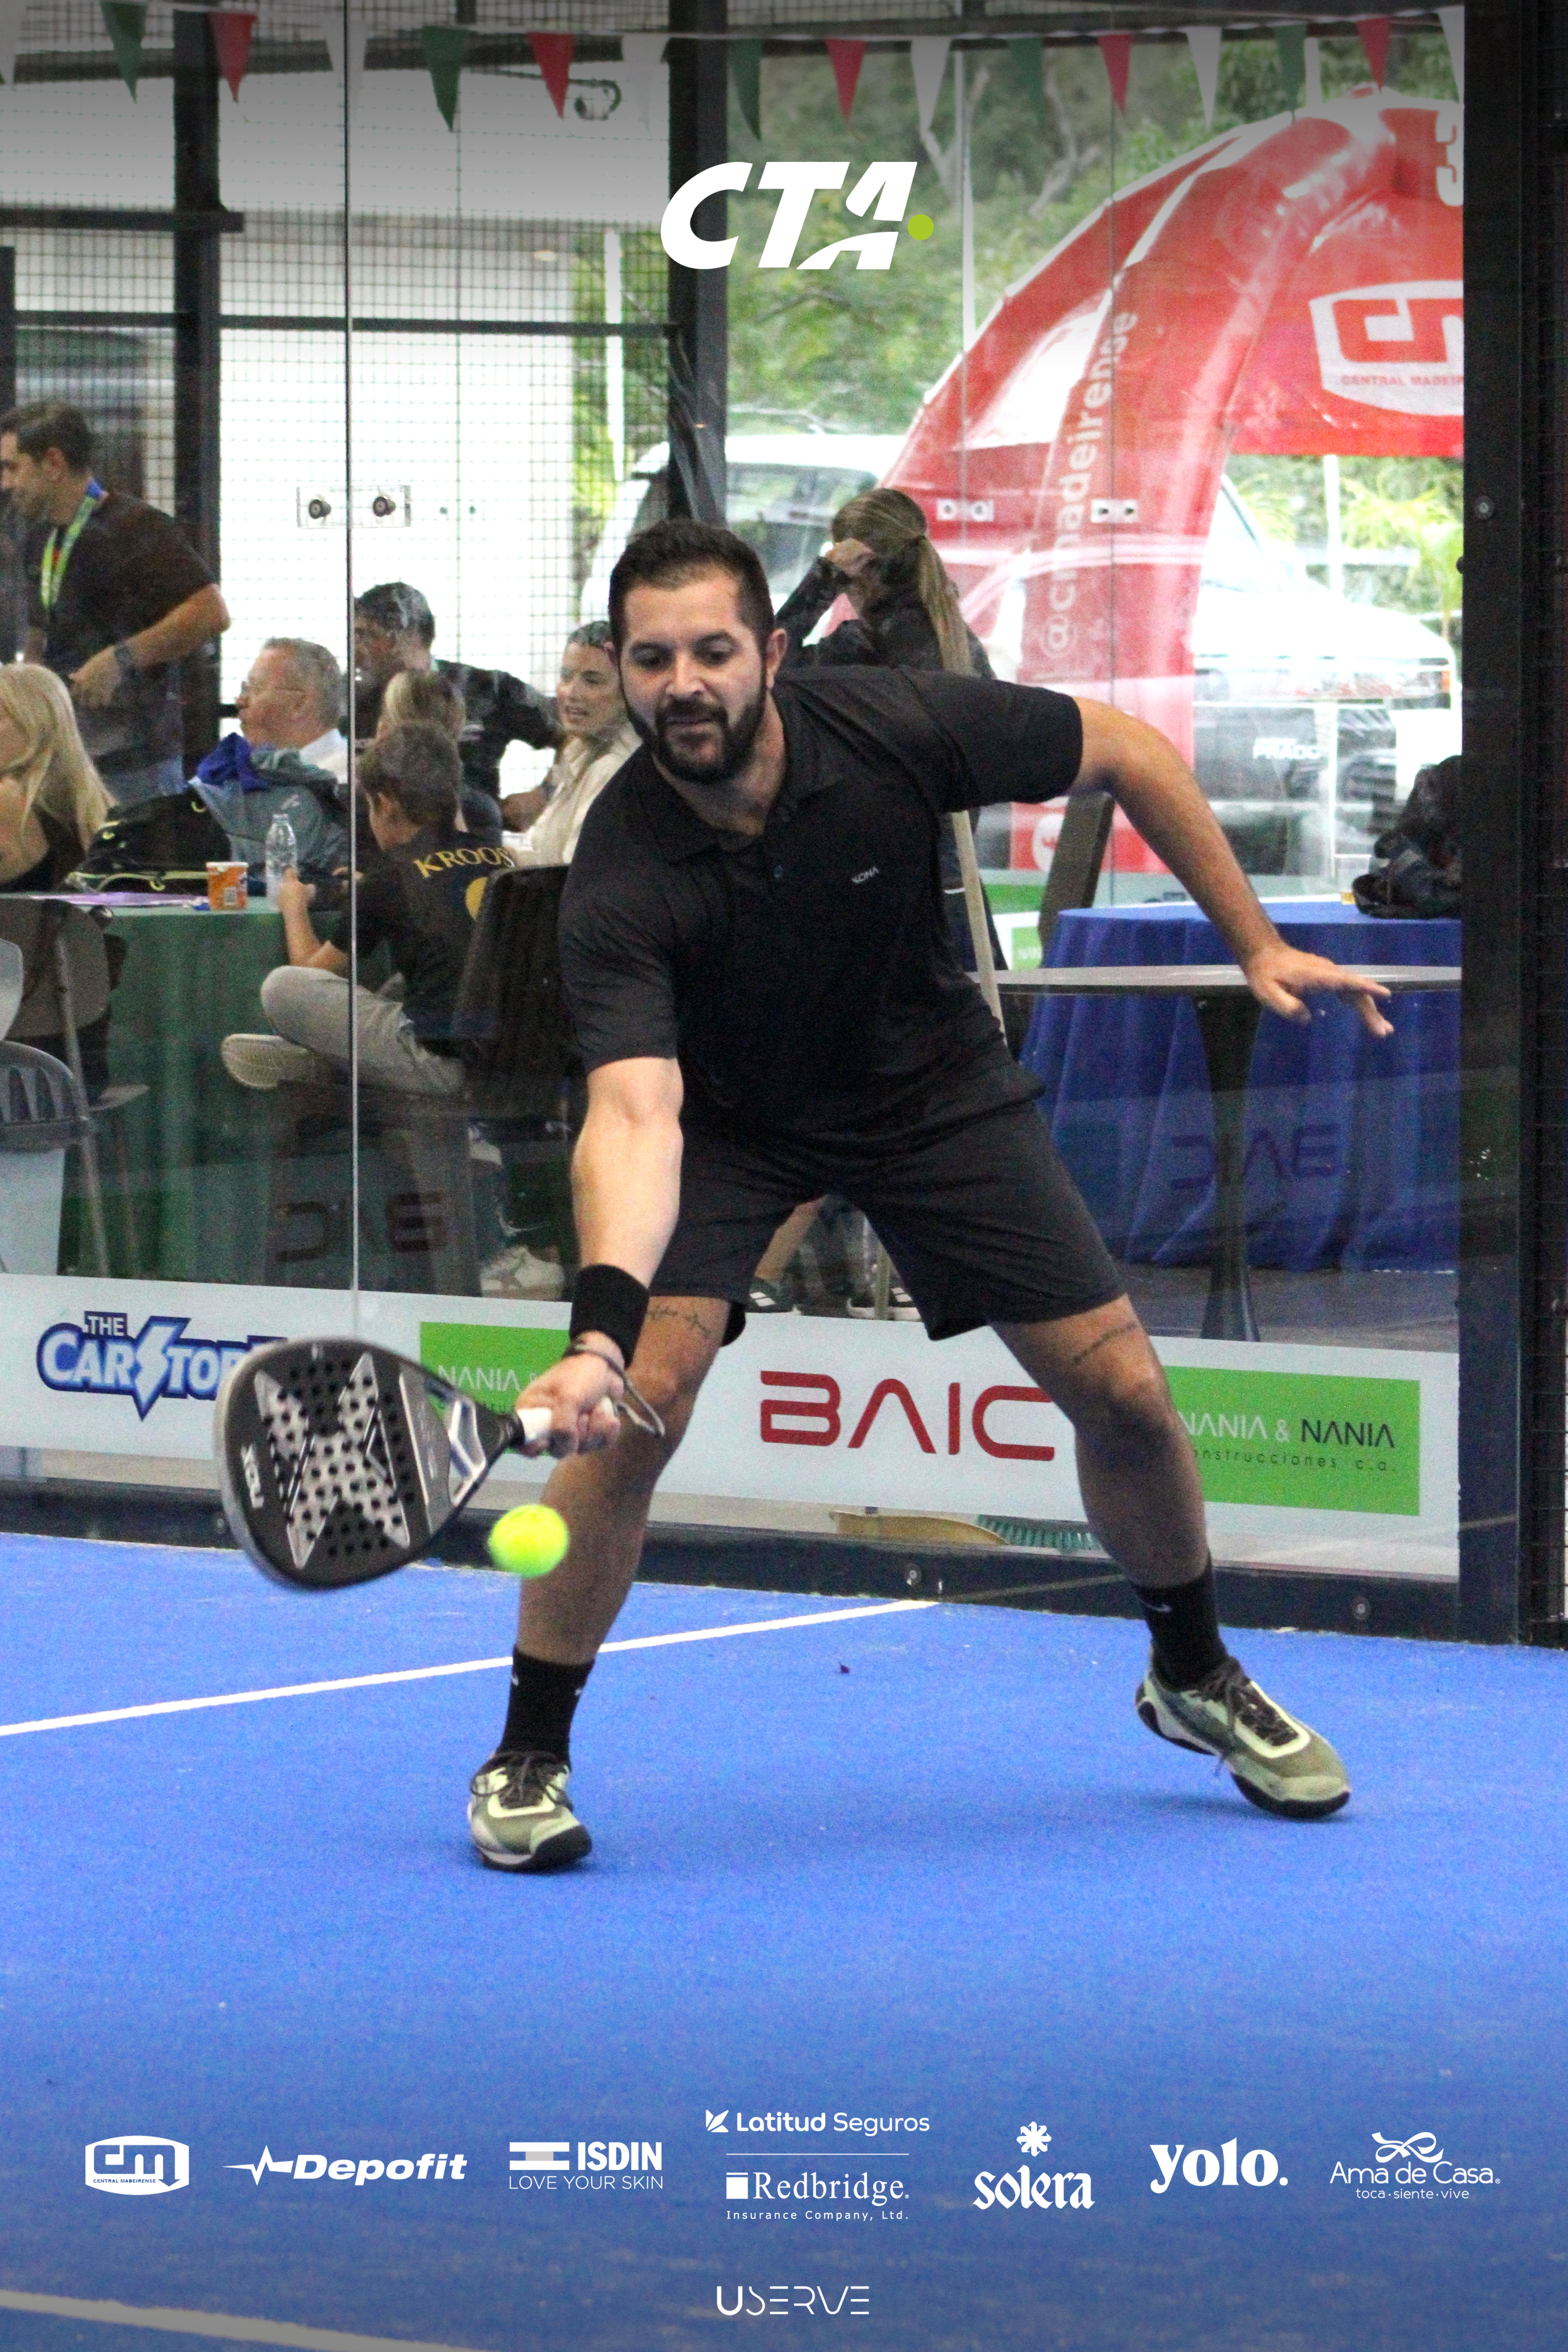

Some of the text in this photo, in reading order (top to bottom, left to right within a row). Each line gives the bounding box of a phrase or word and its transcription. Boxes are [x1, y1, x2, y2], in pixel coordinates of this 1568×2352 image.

[1341, 374, 1405, 386] CENTRAL
[87, 1315, 125, 1336] THE
[437, 1365, 521, 1392] NANIA
[760, 1370, 1055, 1461] BAIC
[1177, 1411, 1395, 1448] NANIA & NANIA
[1194, 1448, 1336, 1468] nstrucciones
